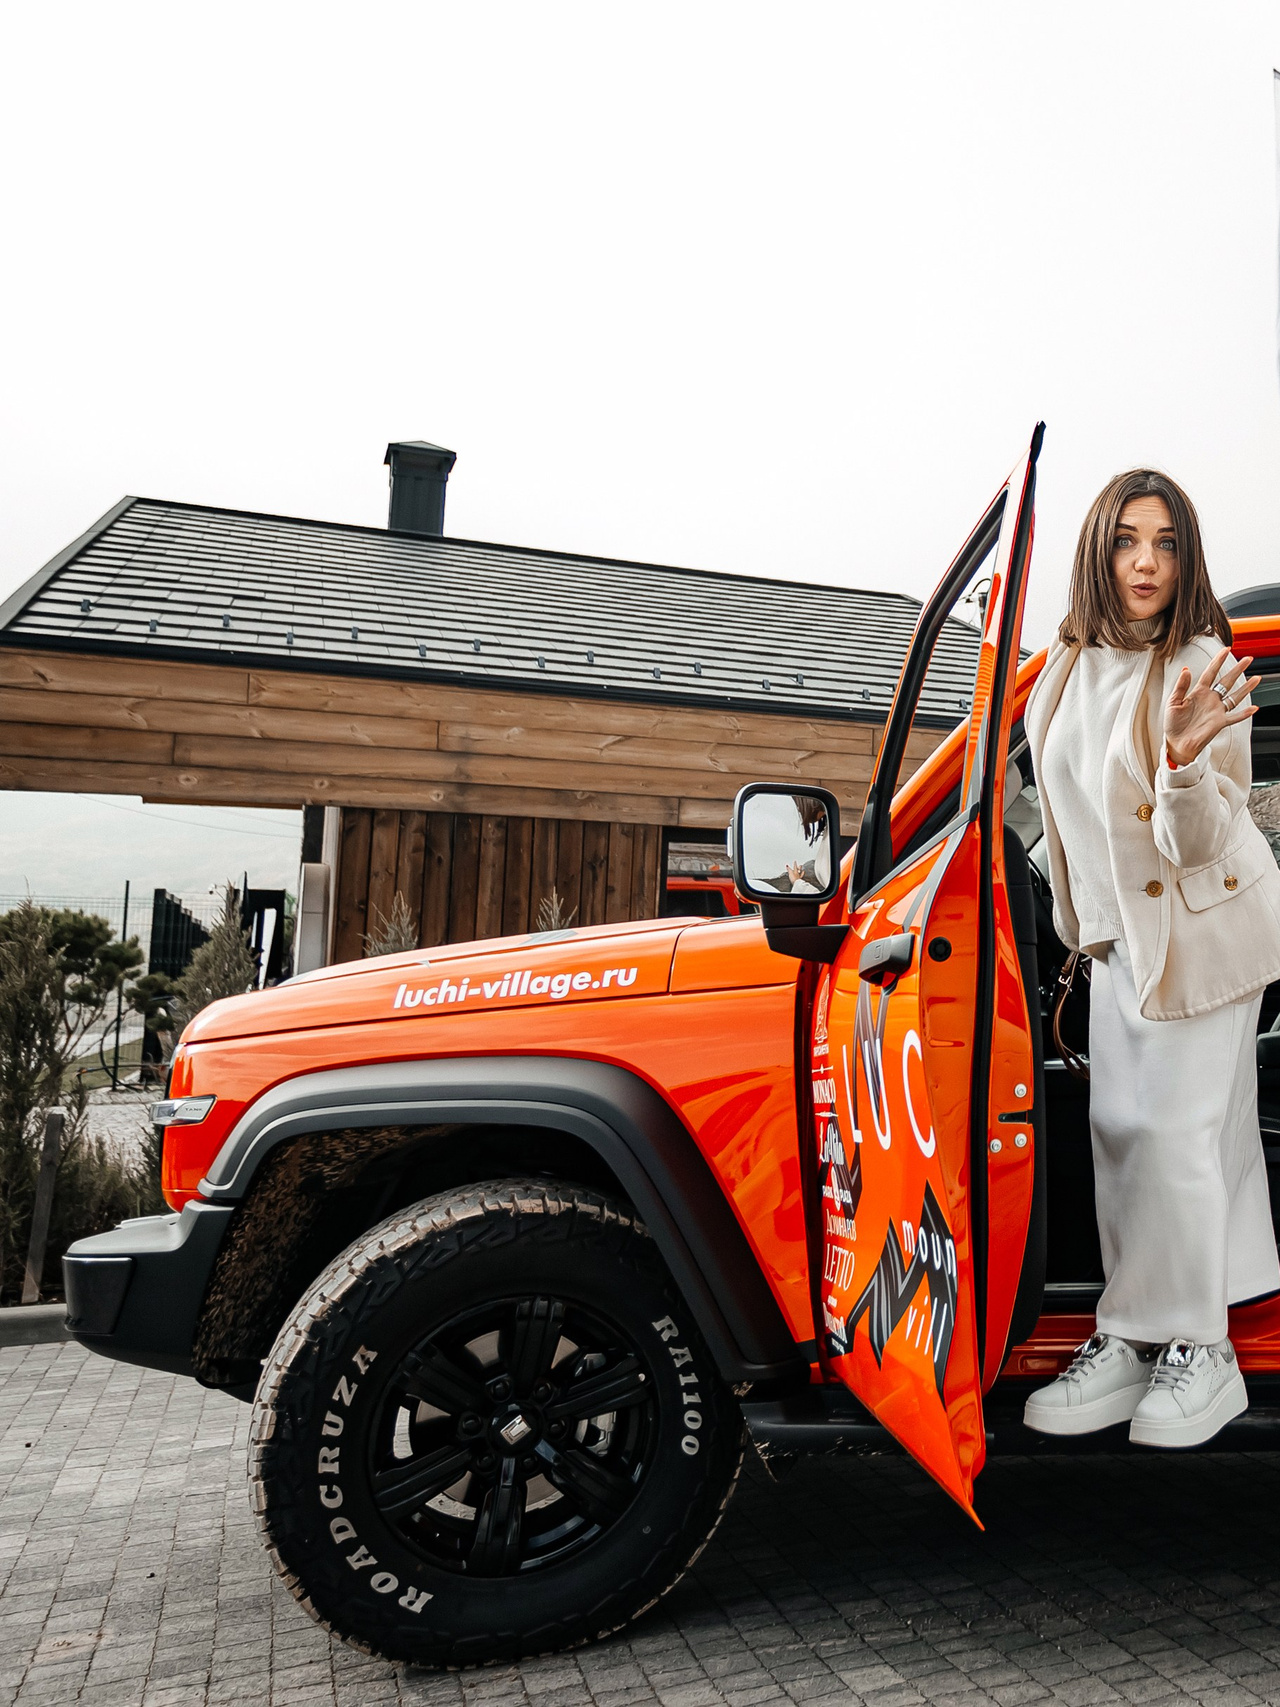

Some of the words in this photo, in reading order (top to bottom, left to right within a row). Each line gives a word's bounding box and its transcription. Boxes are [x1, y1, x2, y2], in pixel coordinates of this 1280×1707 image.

[393, 967, 638, 1009] luchi-village.ru
[812, 1077, 837, 1104] MONACO
[824, 1243, 855, 1291] LETTO
[902, 1220, 957, 1278] moun
[905, 1295, 948, 1363] vill
[318, 1345, 434, 1614] ROADCRUZA
